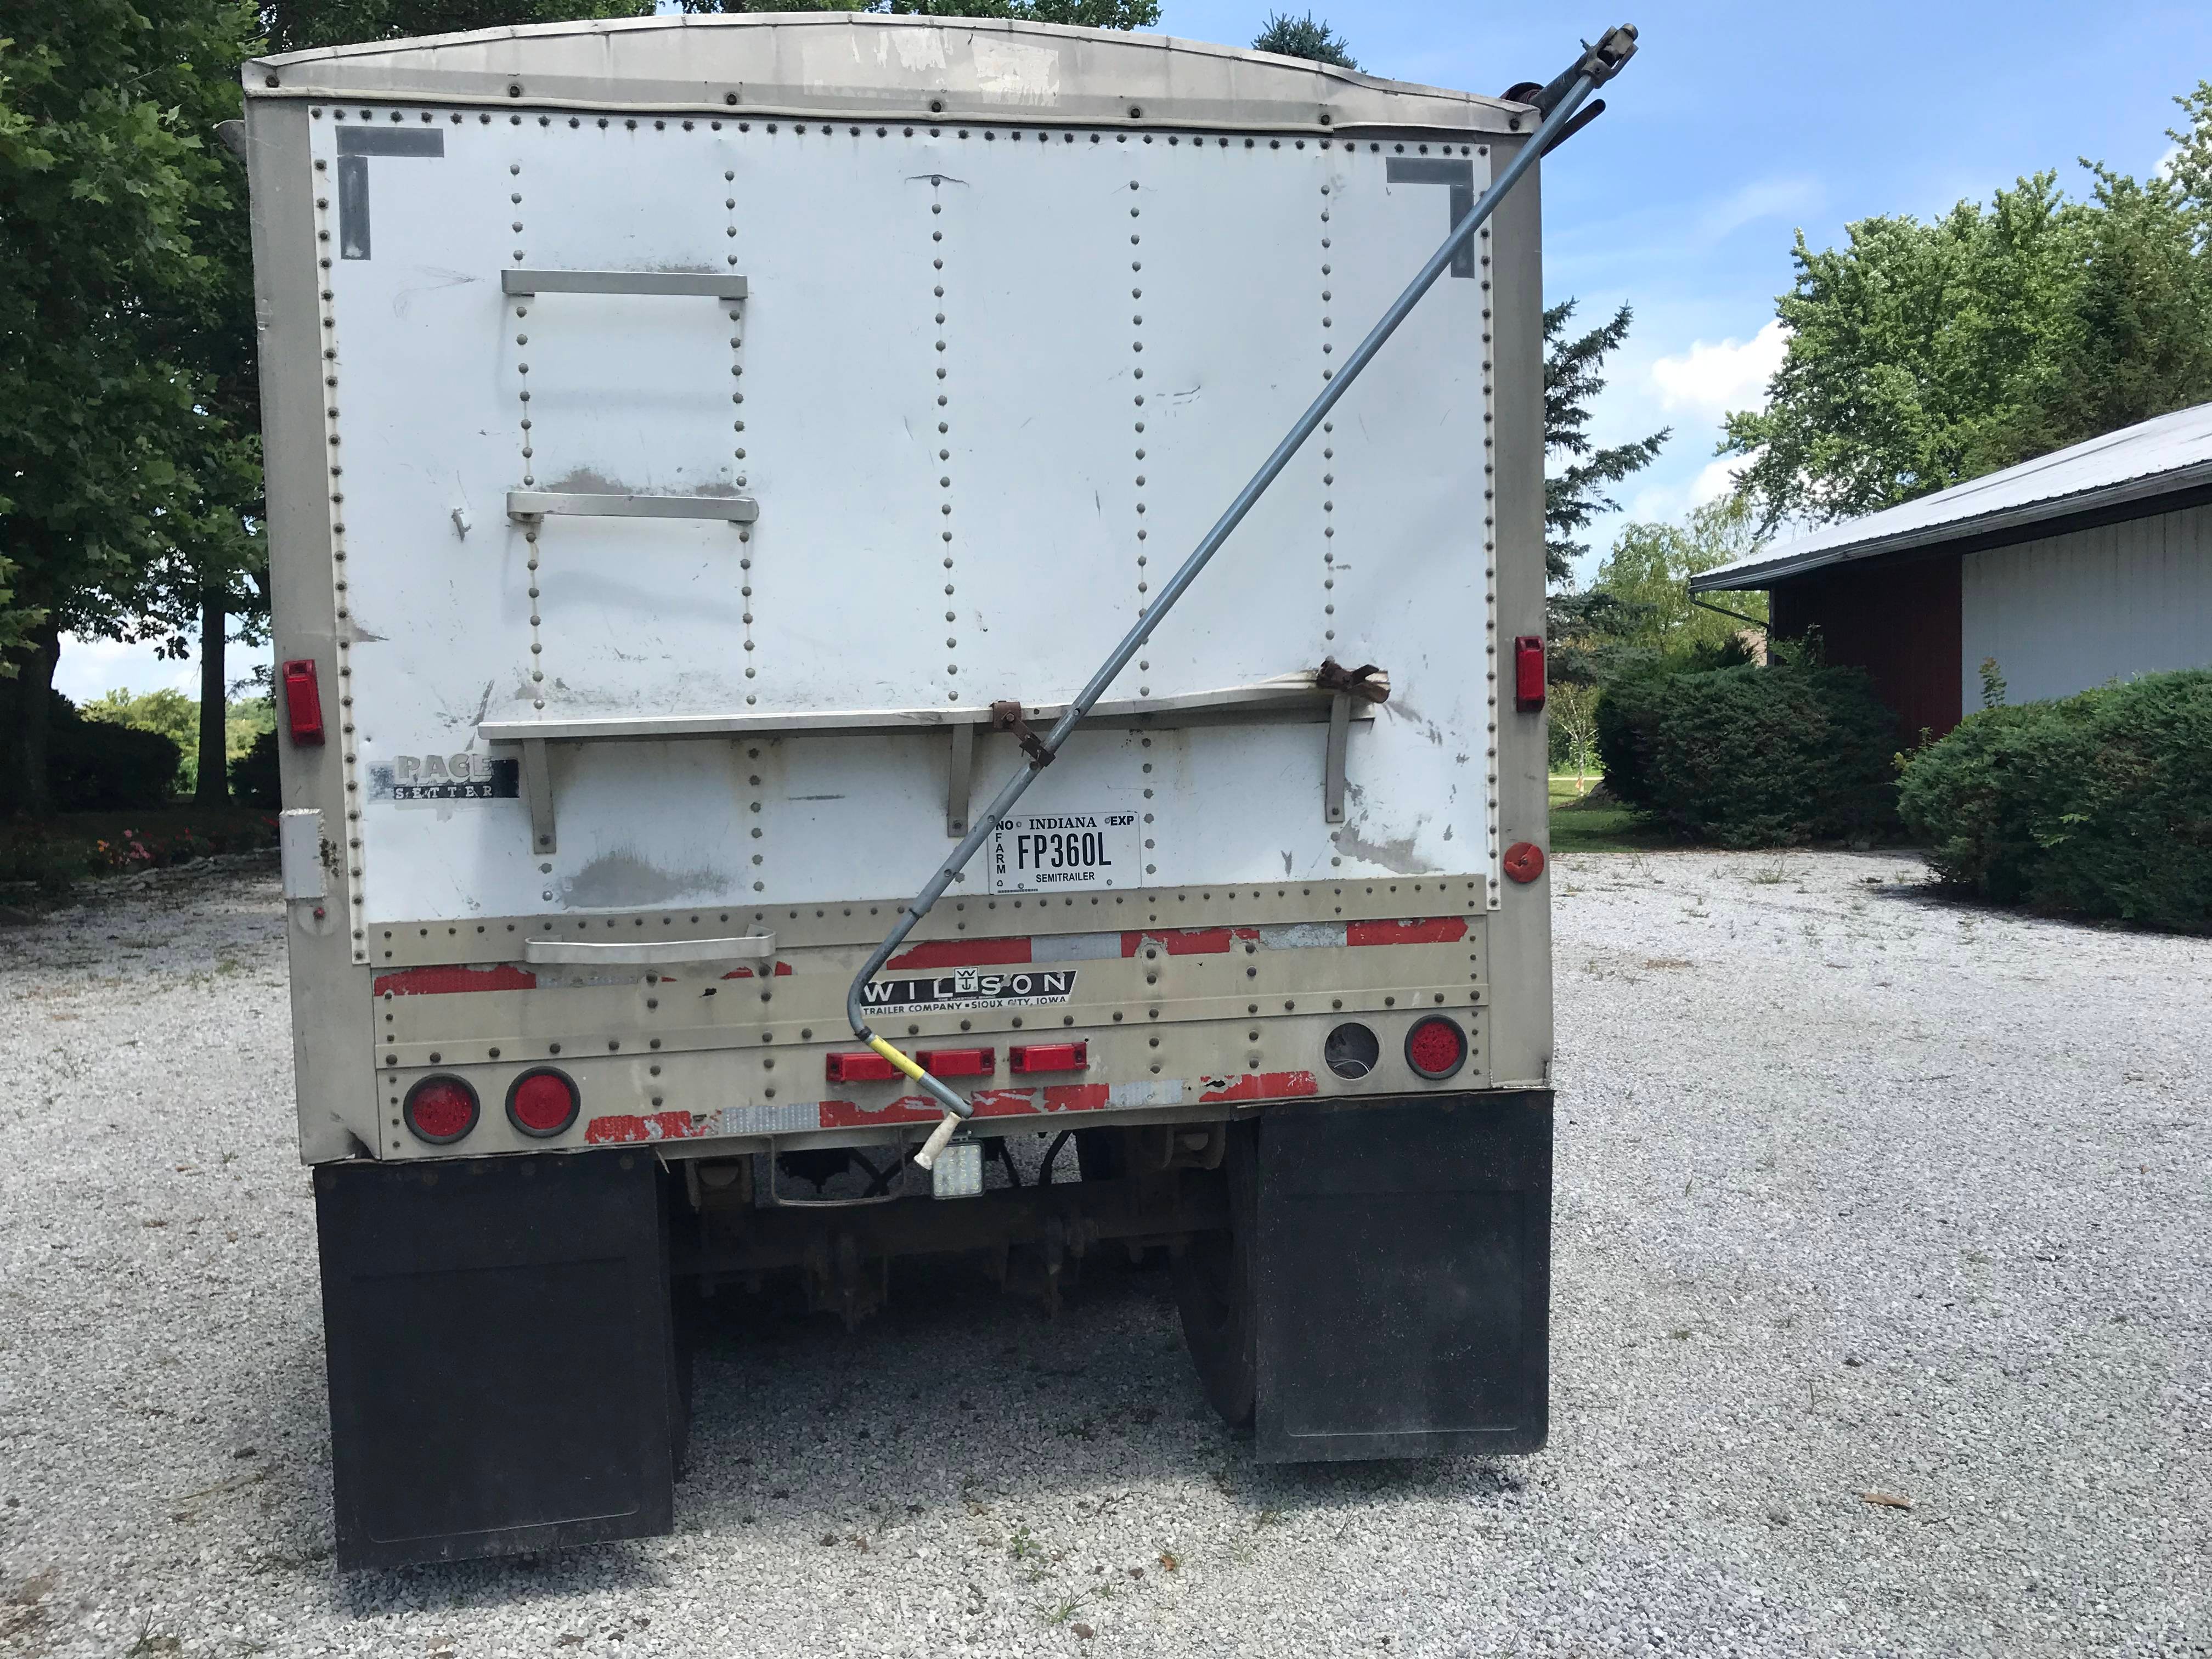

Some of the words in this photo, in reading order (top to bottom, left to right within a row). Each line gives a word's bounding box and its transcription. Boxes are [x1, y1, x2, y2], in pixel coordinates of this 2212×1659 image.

[396, 753, 493, 781] PACE
[396, 786, 492, 799] SETTER
[996, 820, 1013, 831] NO
[1029, 817, 1097, 830] INDIANA
[1110, 816, 1134, 826] EXP
[995, 833, 1006, 874] FARM
[1018, 832, 1111, 869] FP360L
[1036, 872, 1095, 883] SEMITRAILER
[864, 974, 1065, 1002] WILSON
[864, 1006, 905, 1015] TRAILER
[909, 1002, 962, 1012] COMPANY
[972, 1000, 1003, 1008] SIOUX
[1036, 996, 1065, 1005] IOWA
